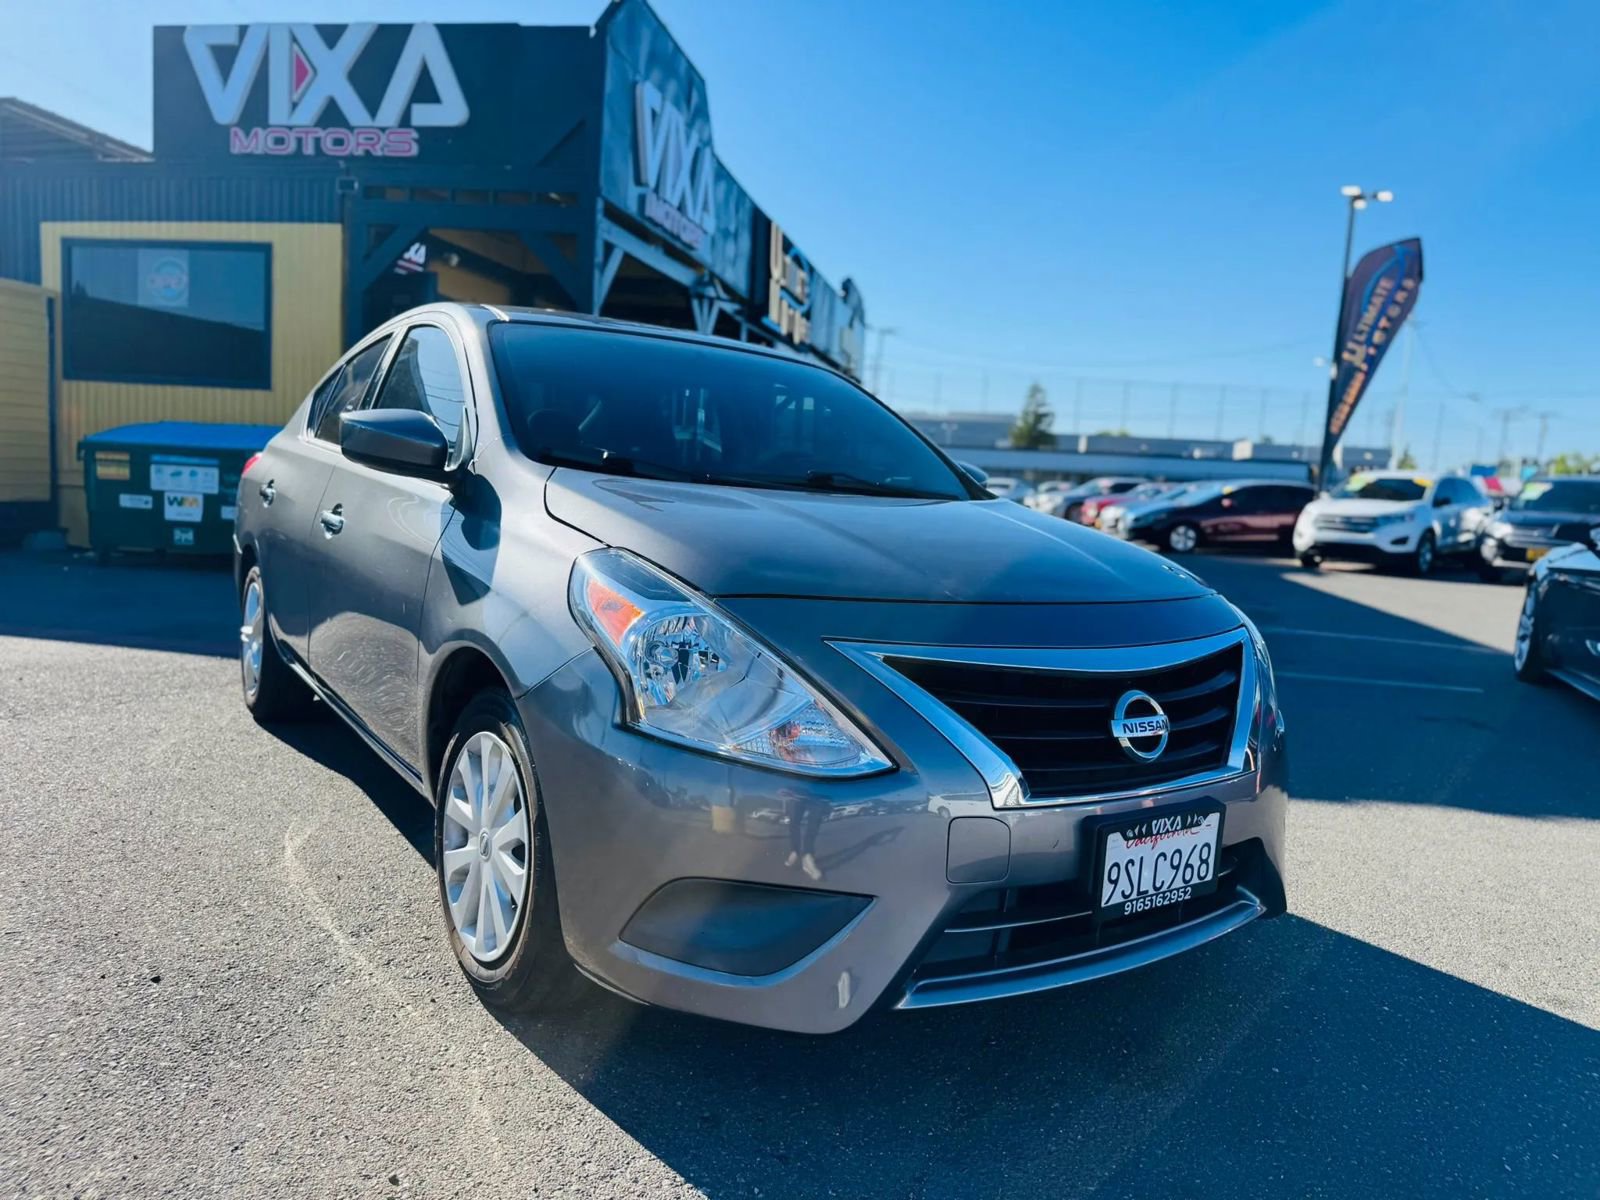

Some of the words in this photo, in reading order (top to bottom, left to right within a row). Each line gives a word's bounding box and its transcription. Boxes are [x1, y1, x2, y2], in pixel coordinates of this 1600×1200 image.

[183, 22, 470, 127] VIXA
[229, 127, 419, 157] MOTORS
[635, 80, 716, 235] VIXA
[1122, 717, 1169, 735] NISSAN
[1151, 815, 1182, 834] VIXA
[1103, 841, 1212, 906] 9SLC968
[1123, 887, 1192, 916] 9165162952
